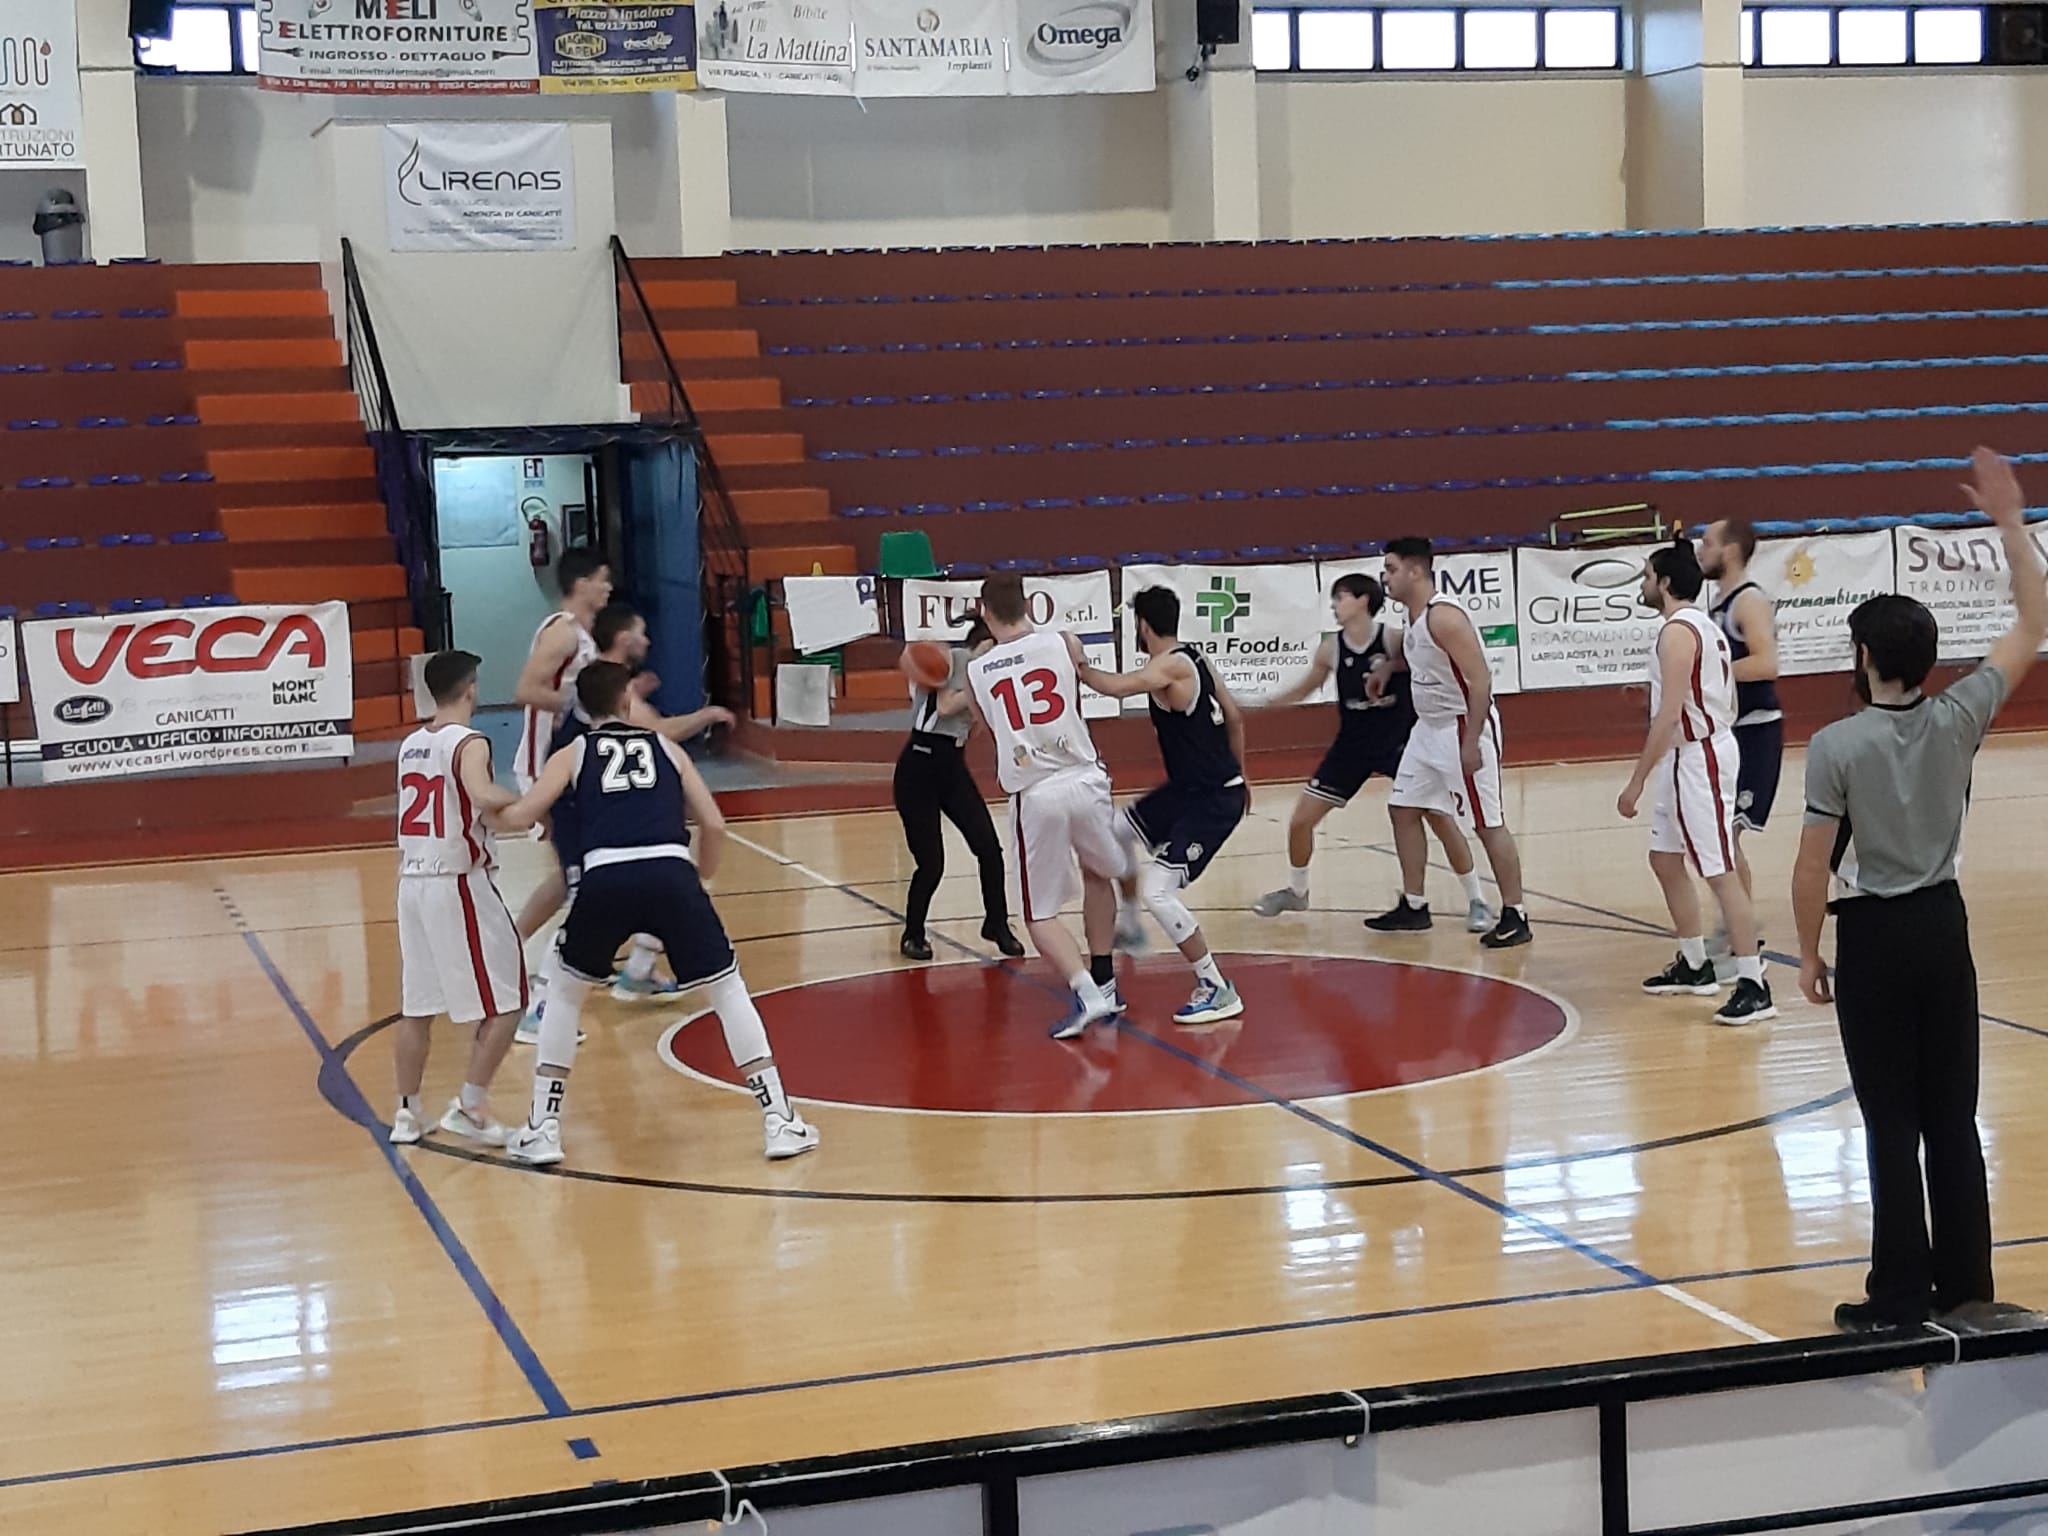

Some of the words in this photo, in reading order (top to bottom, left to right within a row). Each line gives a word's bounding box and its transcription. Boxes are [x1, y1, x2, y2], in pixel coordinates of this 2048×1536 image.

[355, 0, 437, 19] MELI
[278, 21, 508, 42] ELETTROFORNITURE
[1037, 23, 1123, 49] Omega
[309, 50, 387, 60] INGROSSO
[399, 52, 486, 61] DETTAGLIO
[746, 36, 769, 59] La
[774, 38, 849, 62] Mattina
[865, 38, 993, 57] SANTAMARIA
[0, 143, 75, 157] TUNATO
[1908, 579, 1996, 593] TRADING
[1529, 592, 1662, 625] GIESS
[55, 614, 326, 685] VECA
[1226, 636, 1280, 653] Food
[272, 679, 316, 692] MONT
[272, 691, 317, 705] BLANC
[990, 667, 1066, 732] 13
[155, 708, 235, 726] CANICATTI
[61, 742, 134, 758] SCUOLA
[147, 730, 211, 749] UFFICIO
[222, 722, 337, 742] INFORMATICA
[596, 737, 657, 793] 23
[399, 772, 445, 838] 21
